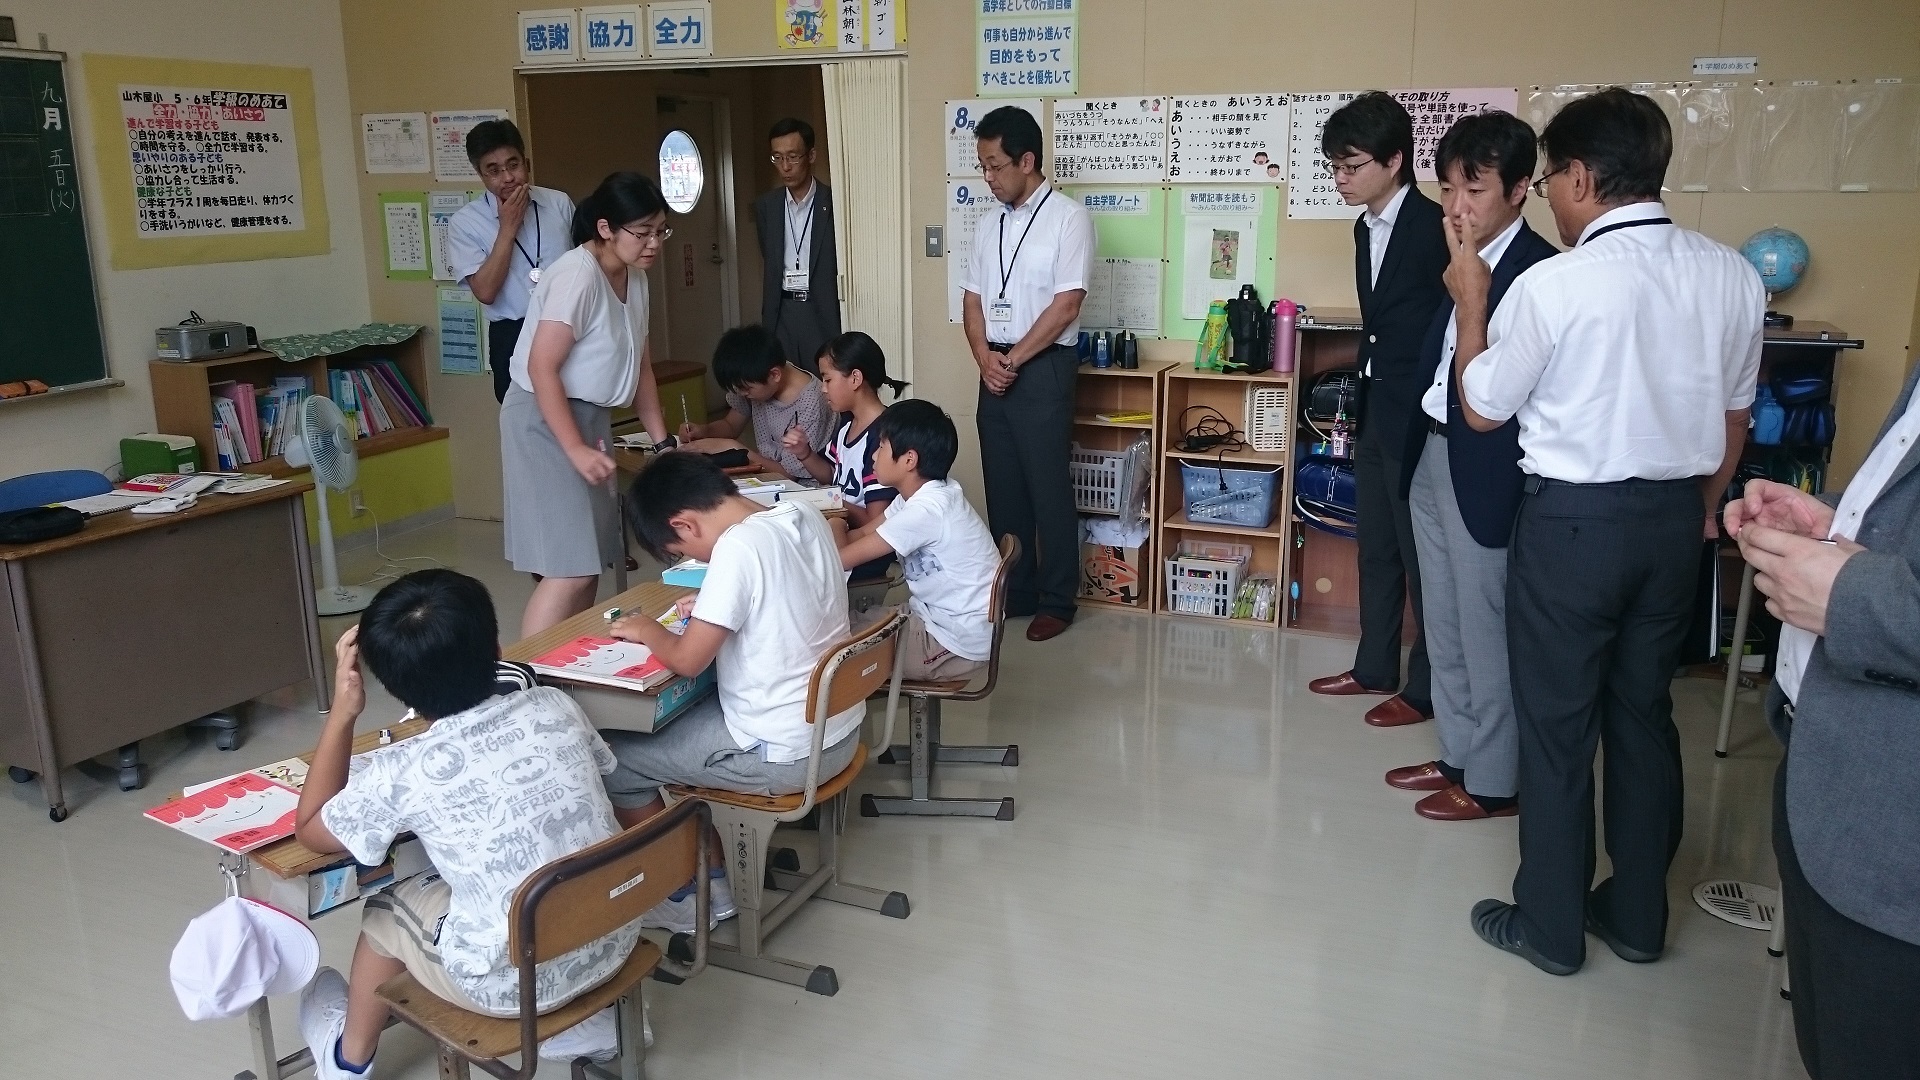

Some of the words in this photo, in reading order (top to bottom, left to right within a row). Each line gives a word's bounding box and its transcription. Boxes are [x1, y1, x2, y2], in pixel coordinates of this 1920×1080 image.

[842, 0, 857, 44] 林朝夜
[588, 20, 633, 48] 協力
[656, 16, 701, 44] 全力
[984, 26, 1071, 42] 何事も自分から進んで
[526, 24, 569, 51] 感謝
[990, 48, 1061, 64] 目的をもって
[983, 70, 1071, 86] すべきことを優先して
[1086, 102, 1118, 111] 聞くとき
[1176, 100, 1217, 108] 聞くときの
[1227, 96, 1288, 107] あいうえお
[1055, 112, 1103, 120] あいづちをうつ
[1172, 110, 1182, 122] あ
[127, 118, 219, 130] 進んで学習する子ども
[132, 152, 224, 163] 思いやりのある子ども
[136, 187, 193, 198] 健康な子ども
[1190, 192, 1256, 202] 新聞記事を読もう
[1084, 194, 1140, 206] 自主学習ノート
